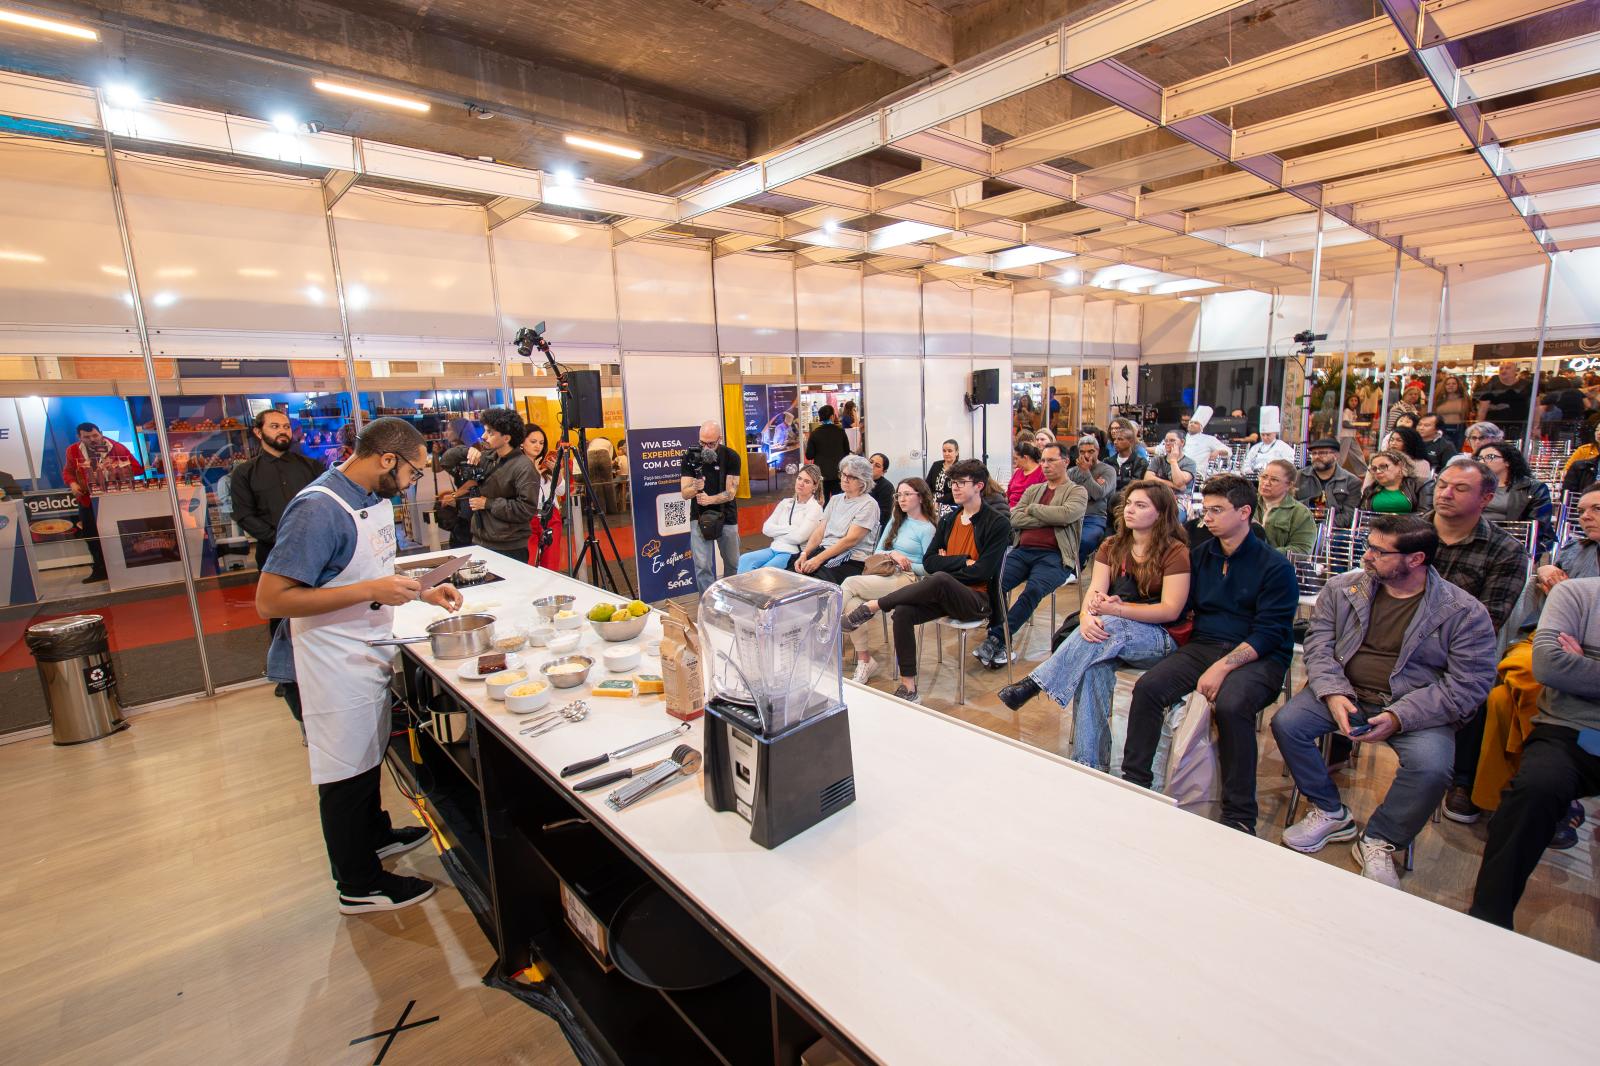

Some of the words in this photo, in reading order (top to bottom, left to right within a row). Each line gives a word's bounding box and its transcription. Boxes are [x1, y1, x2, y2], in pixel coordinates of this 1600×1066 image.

[641, 441, 660, 449] VIVA
[662, 440, 682, 448] ESSA
[643, 461, 661, 470] COM
[663, 460, 670, 468] A
[671, 459, 682, 467] GE
[652, 554, 665, 574] Eu
[666, 552, 684, 567] estive
